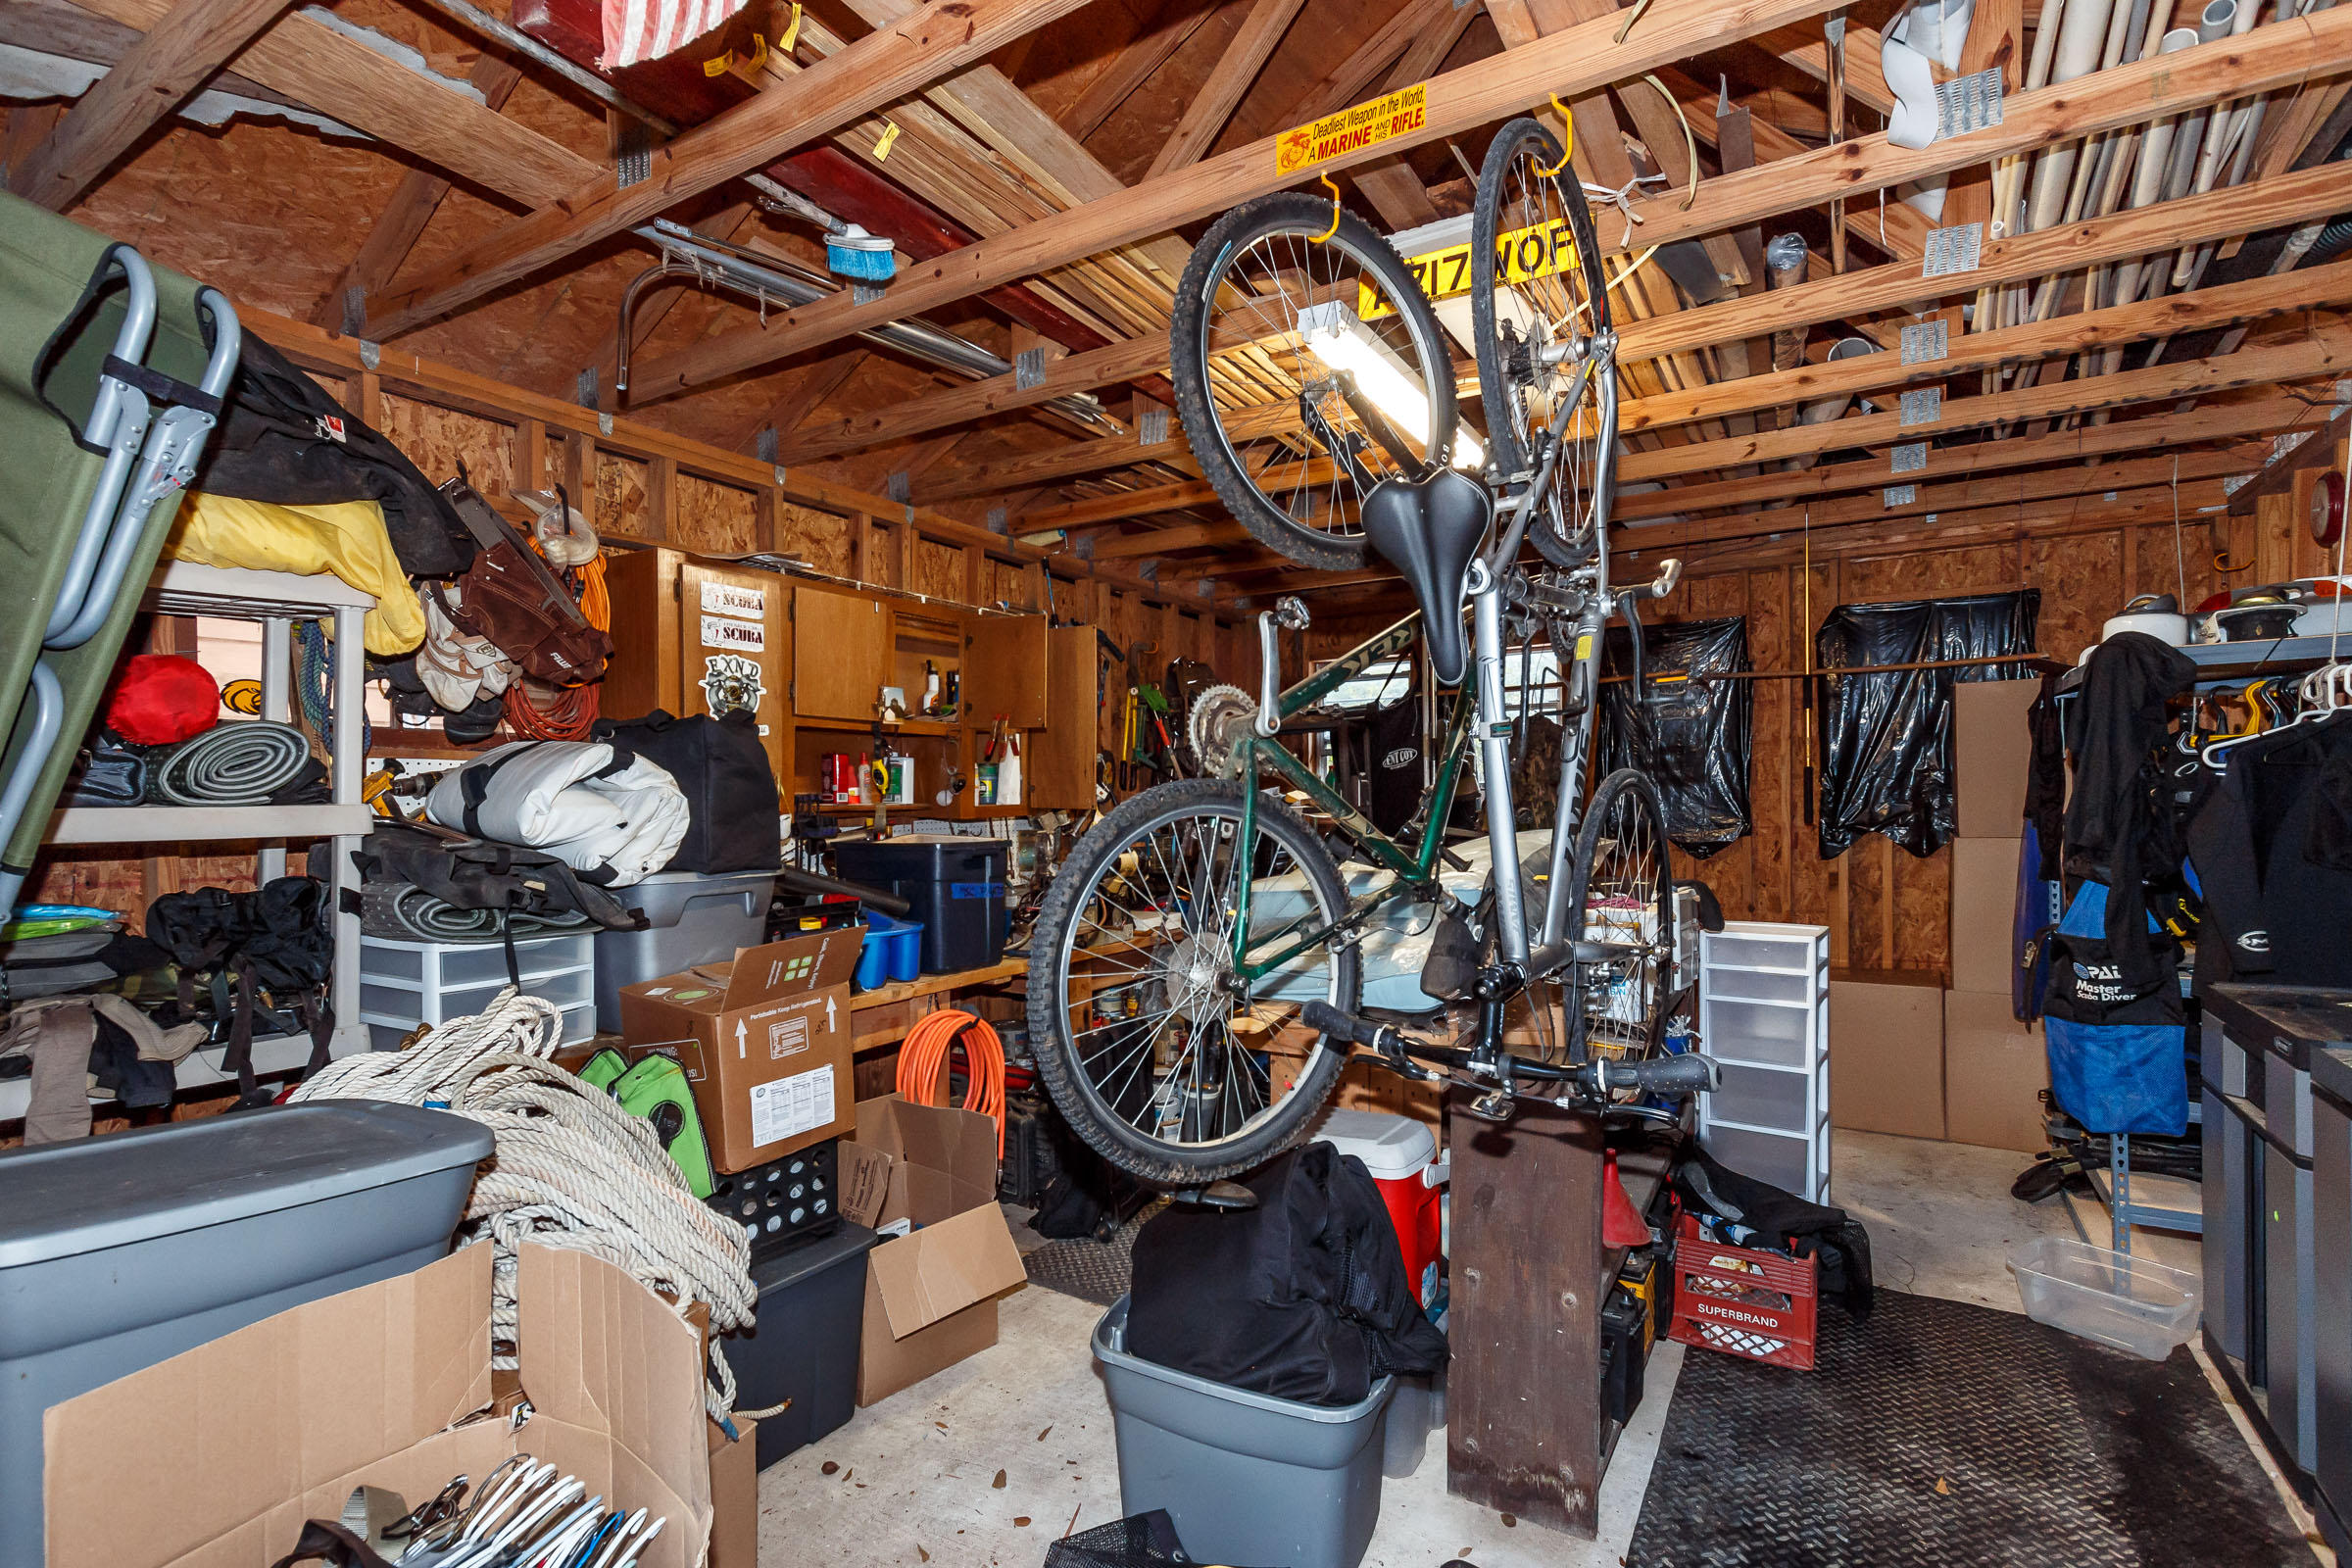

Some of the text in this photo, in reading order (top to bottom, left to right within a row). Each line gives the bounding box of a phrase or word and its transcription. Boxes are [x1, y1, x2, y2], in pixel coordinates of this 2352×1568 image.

[1313, 113, 1347, 140] Deadliest
[1348, 106, 1377, 131] Weapon
[1379, 100, 1387, 117] in
[1387, 96, 1398, 114] the
[1307, 107, 1425, 163] A MARINE AND HIS RIFLE.
[722, 592, 763, 611] SCUBA
[722, 626, 763, 644] SCUBA
[2076, 980, 2122, 994] Master
[2077, 991, 2136, 1002] Scuba Diver
[1697, 1302, 1779, 1328] SUPERBRAND
